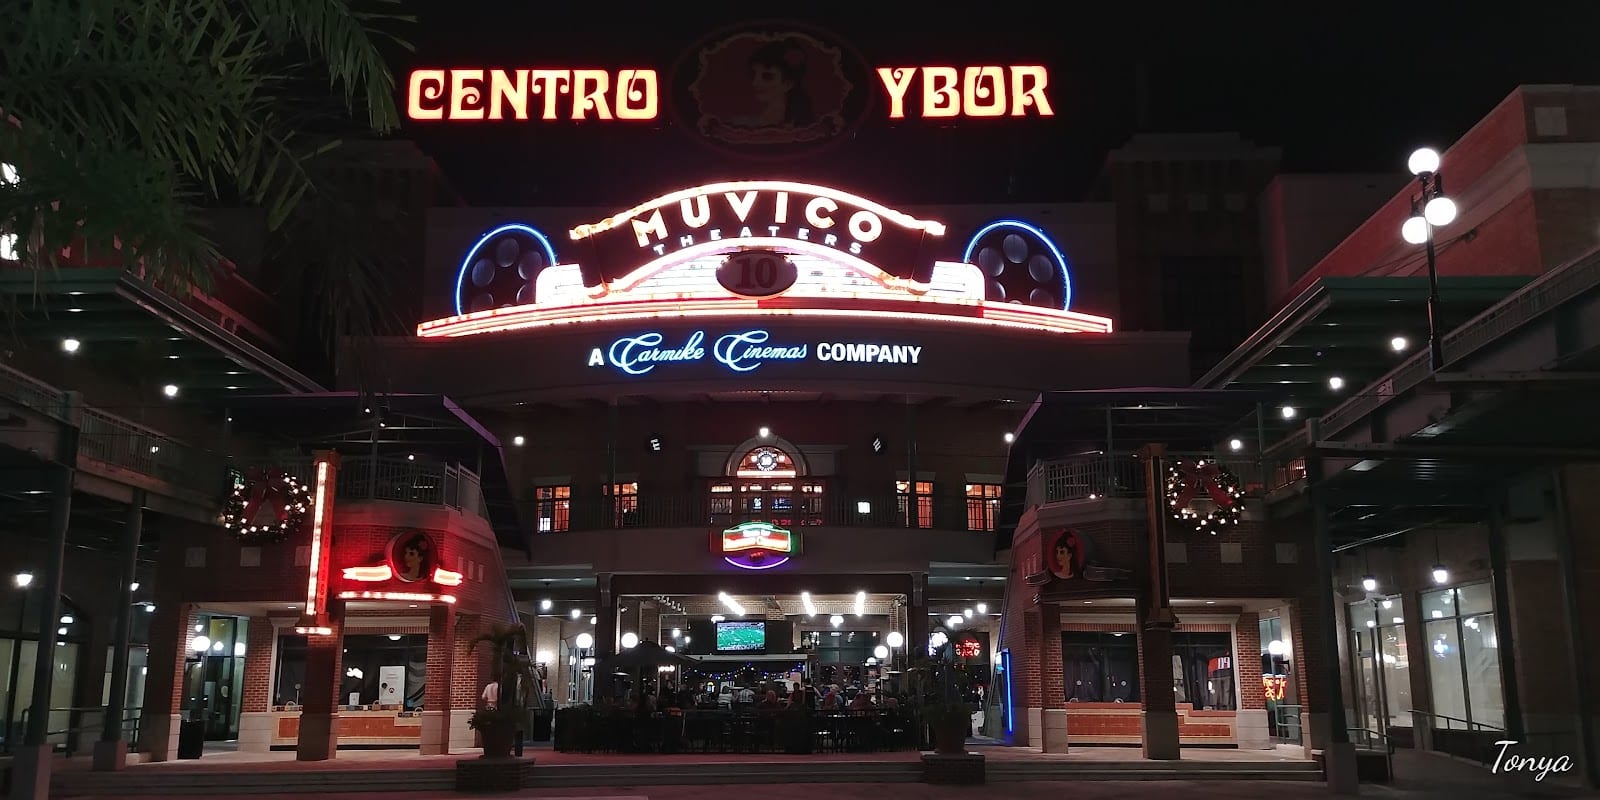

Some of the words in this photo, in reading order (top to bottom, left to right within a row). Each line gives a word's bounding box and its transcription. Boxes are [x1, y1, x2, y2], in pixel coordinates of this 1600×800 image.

[407, 69, 658, 120] CENTRO
[876, 65, 1053, 118] YBOR
[631, 190, 882, 247] MUVICO
[653, 225, 863, 255] THEATERS
[736, 257, 777, 289] 10
[588, 349, 604, 367] A
[609, 330, 705, 374] Carmike
[714, 329, 808, 372] Cinemas
[816, 344, 922, 364] COMPANY
